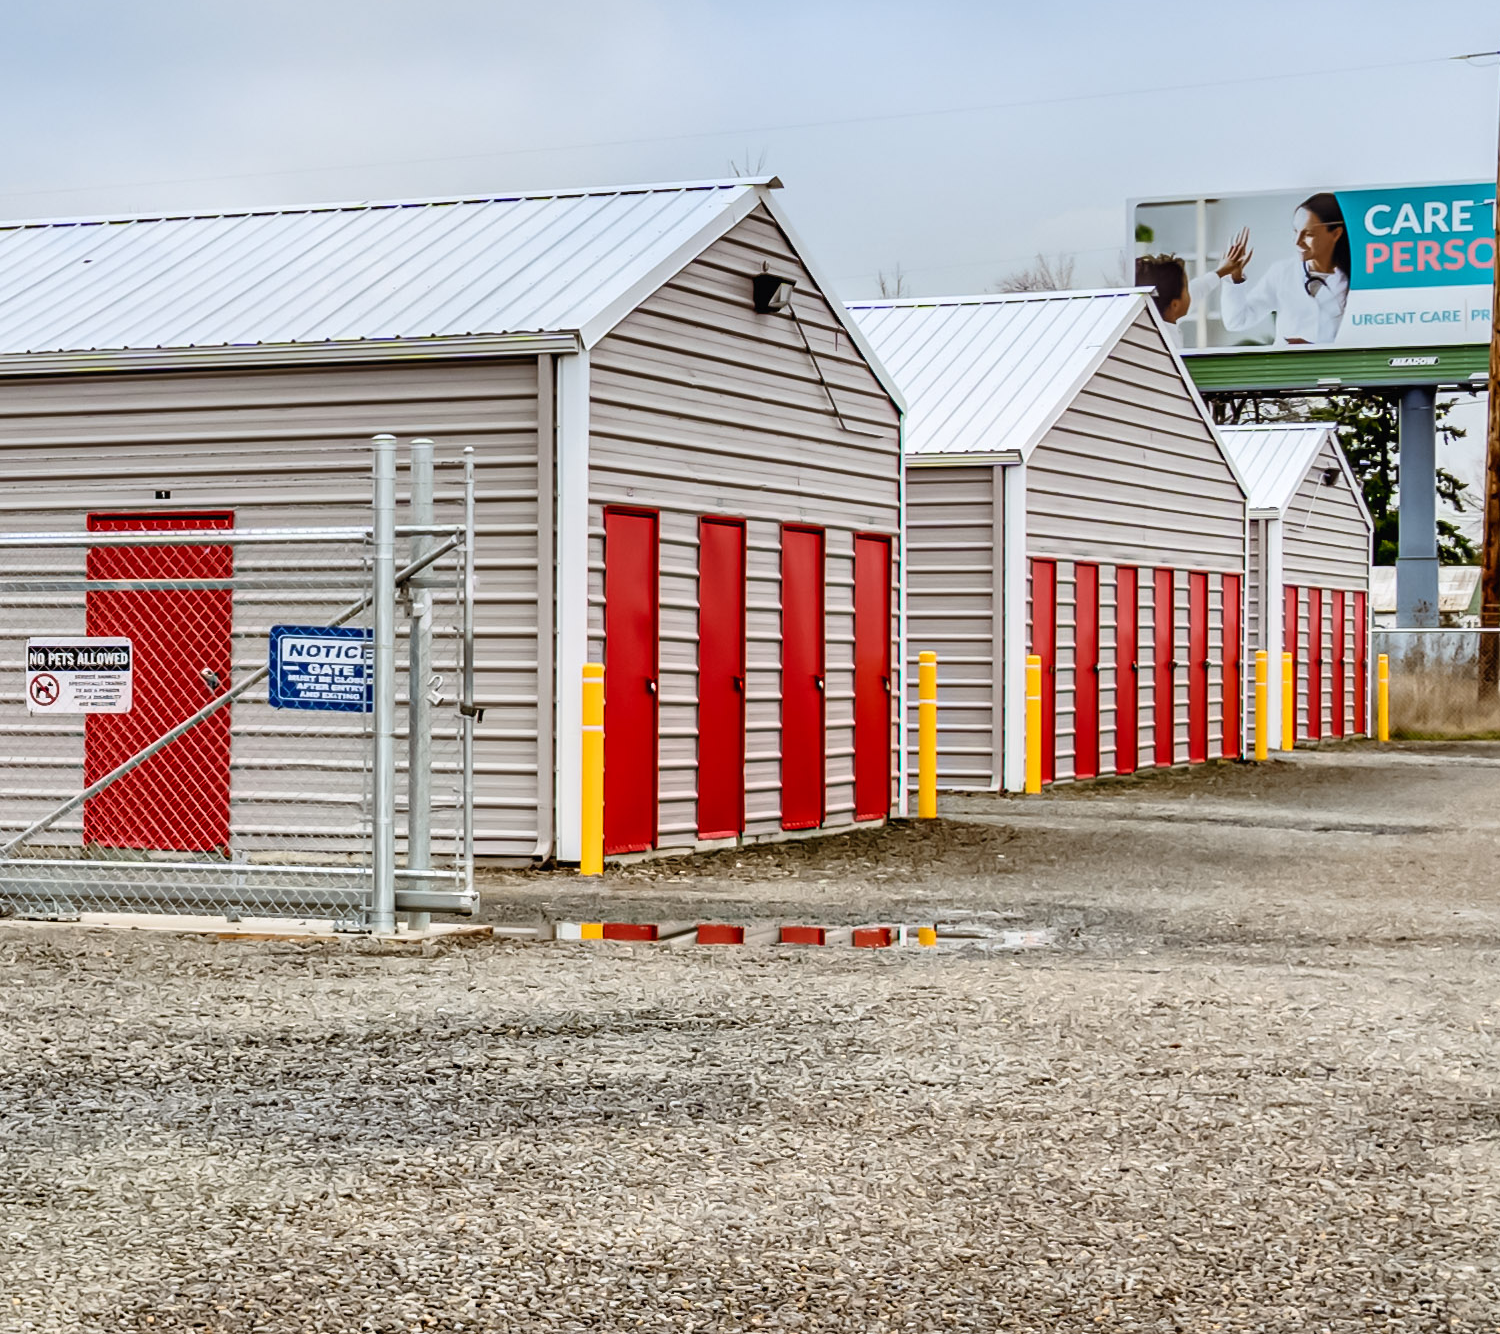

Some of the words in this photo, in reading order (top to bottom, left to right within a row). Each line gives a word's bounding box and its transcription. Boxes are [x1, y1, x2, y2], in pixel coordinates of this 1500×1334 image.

[1364, 200, 1474, 236] CARE
[1352, 311, 1417, 326] URGENT
[1420, 310, 1461, 324] CARE
[289, 643, 374, 660] NOTICE
[29, 652, 46, 666] NO
[48, 652, 75, 666] PETS
[77, 652, 129, 666] ALLOWED
[307, 663, 355, 676] GATE
[287, 674, 317, 682] MUST
[318, 675, 333, 683] BE
[296, 682, 330, 691] AFTER
[331, 684, 365, 692] ENTRY
[299, 690, 321, 698] AND
[321, 691, 361, 700] EXITING
